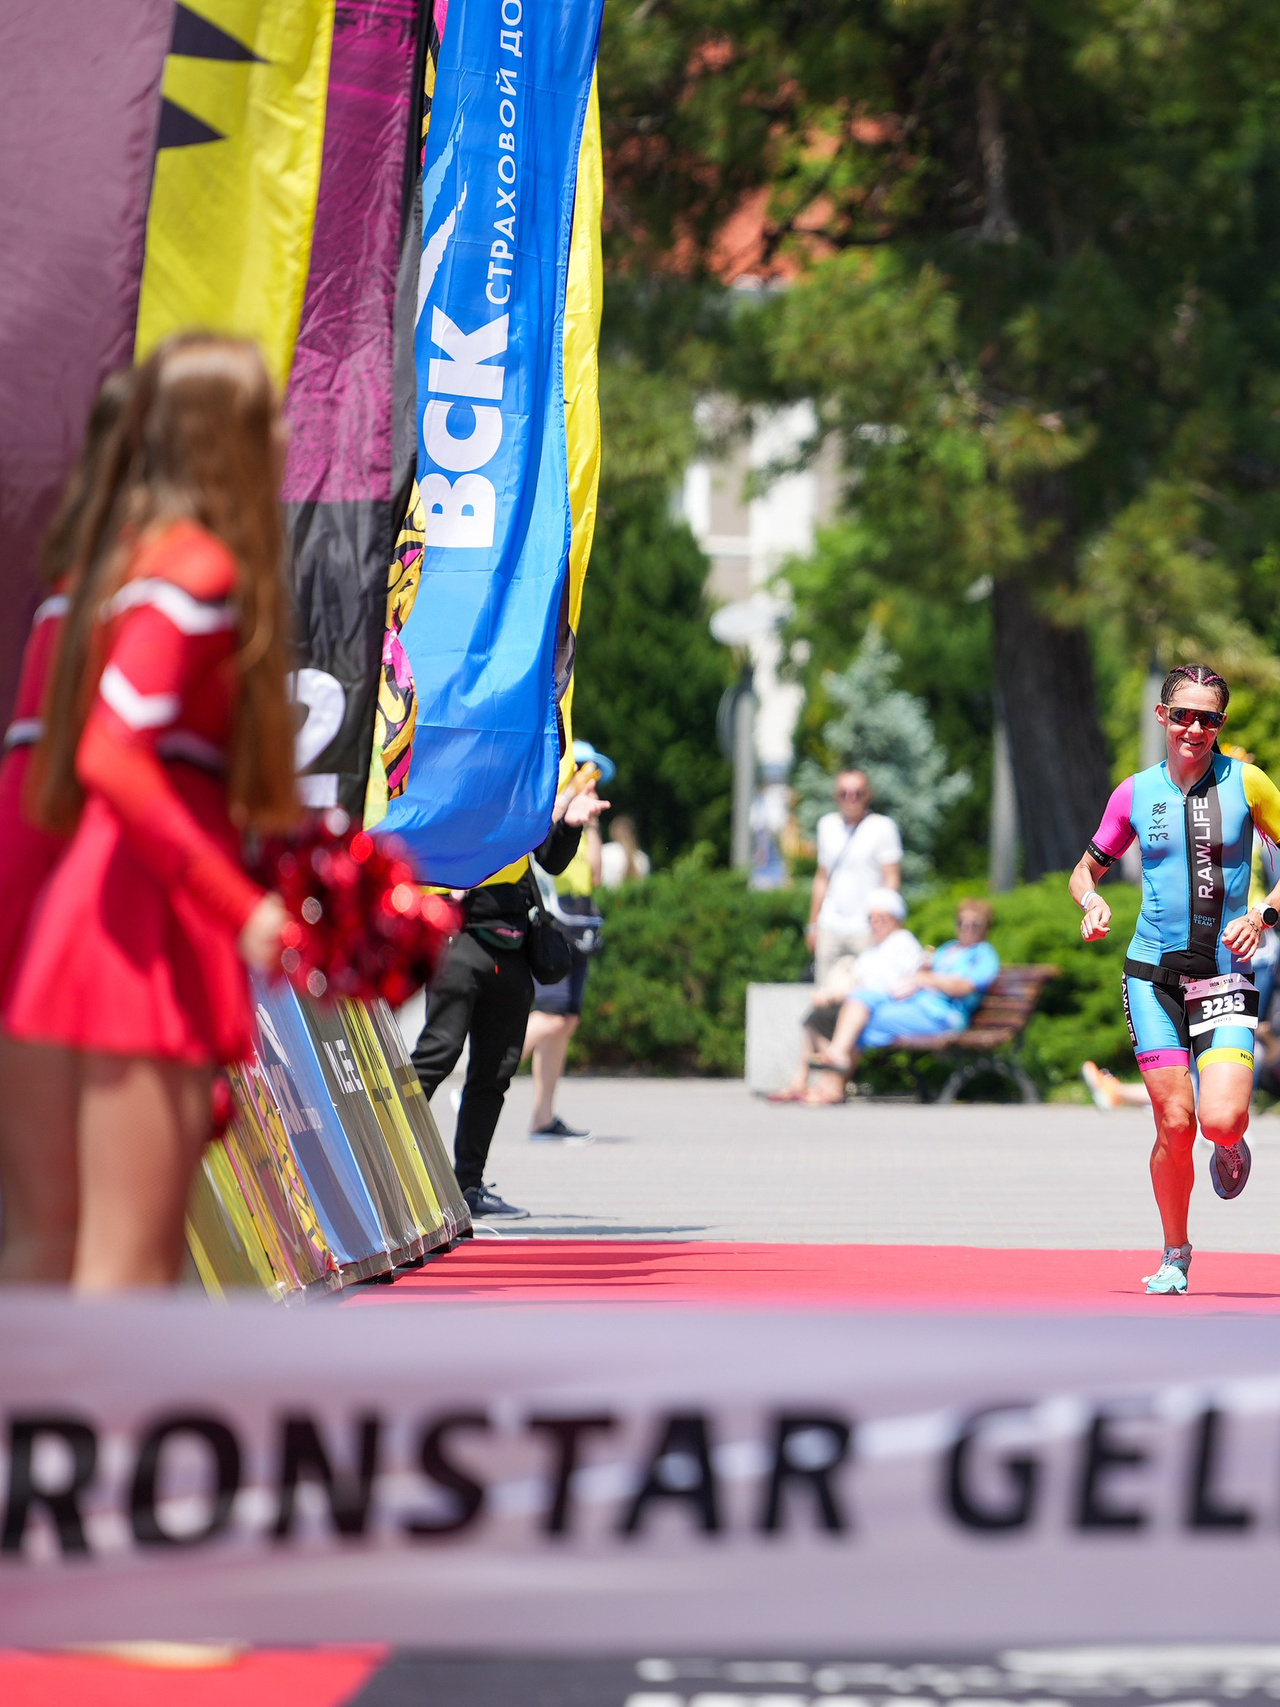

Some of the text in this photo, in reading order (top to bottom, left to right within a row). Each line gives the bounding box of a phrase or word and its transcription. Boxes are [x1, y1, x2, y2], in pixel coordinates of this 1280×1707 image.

[485, 70, 518, 305] СТРАХОВОЙ
[422, 305, 509, 548] ВСК
[1148, 832, 1170, 842] TYR
[1193, 914, 1216, 923] SPORT
[1193, 919, 1213, 928] TEAM
[1201, 992, 1245, 1020] 3233
